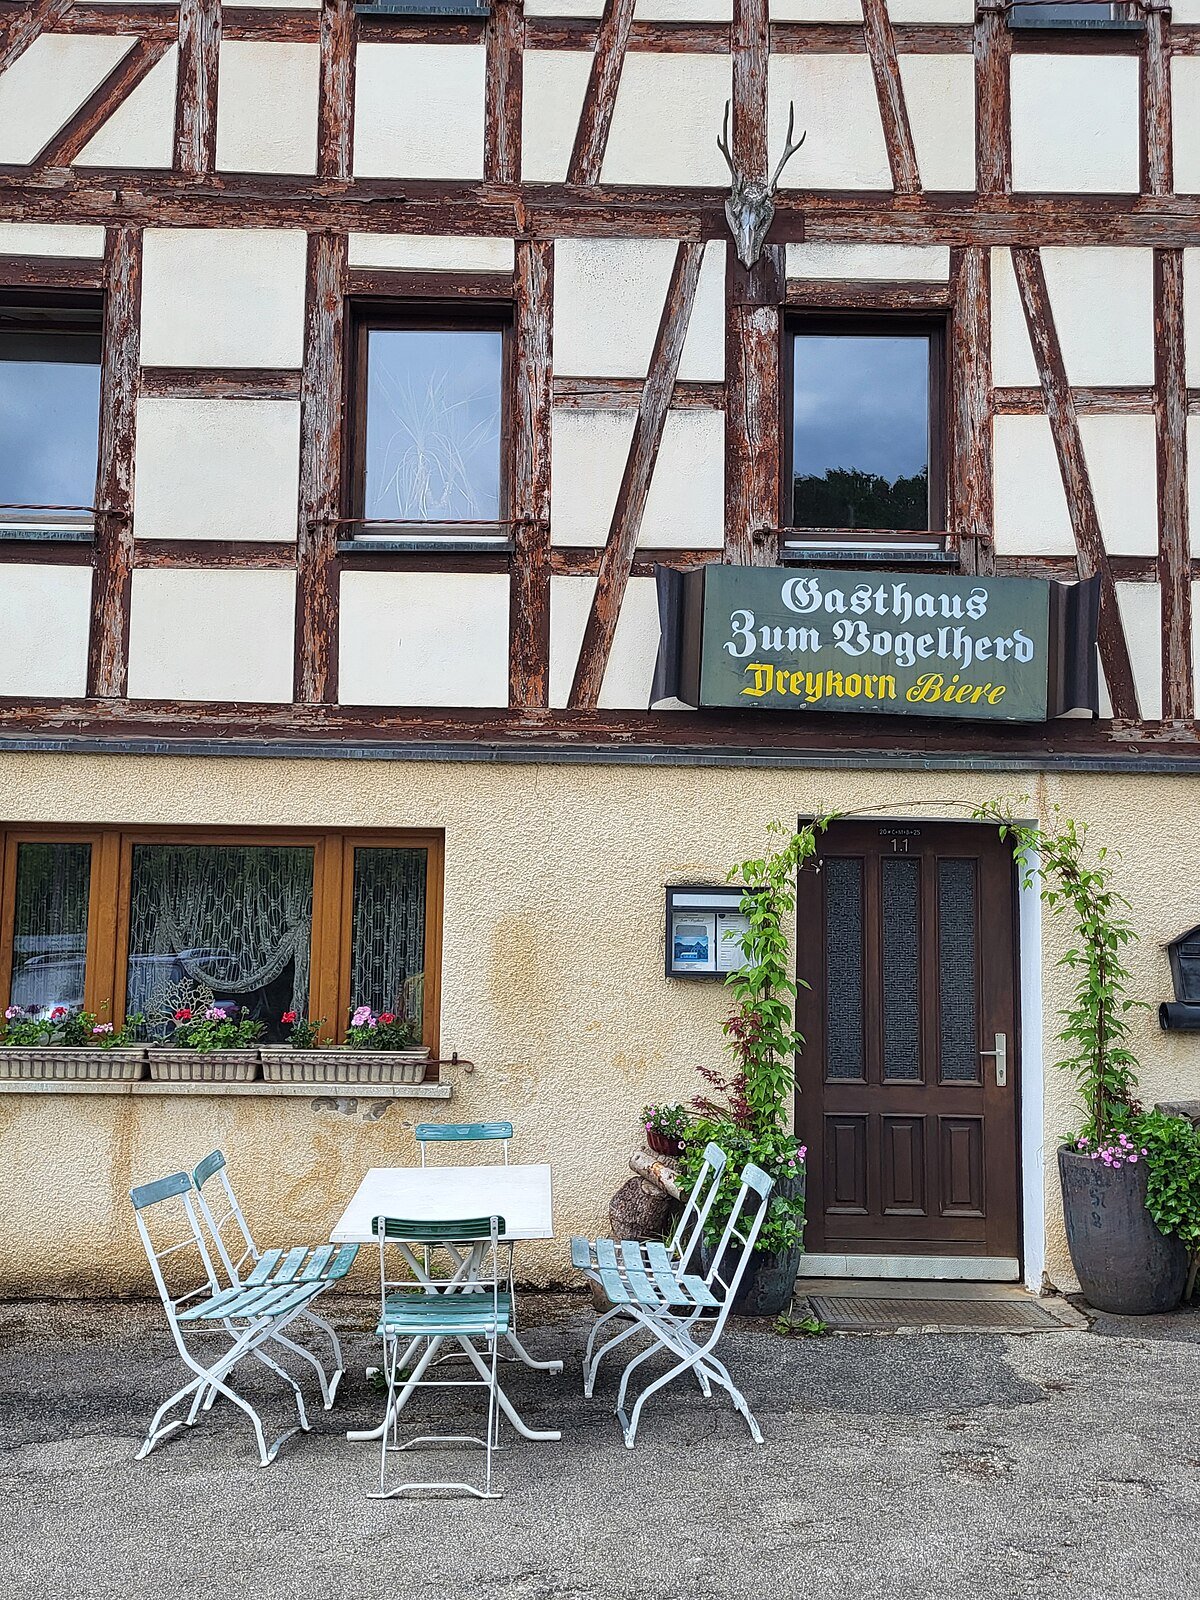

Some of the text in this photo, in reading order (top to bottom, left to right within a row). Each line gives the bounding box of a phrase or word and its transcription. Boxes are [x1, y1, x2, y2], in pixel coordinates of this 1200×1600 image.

[781, 577, 989, 625] Gasthaus
[723, 609, 1034, 671] Zum Vogelherd
[740, 663, 1007, 705] Dreykorn Biere
[890, 838, 909, 852] 1.1
